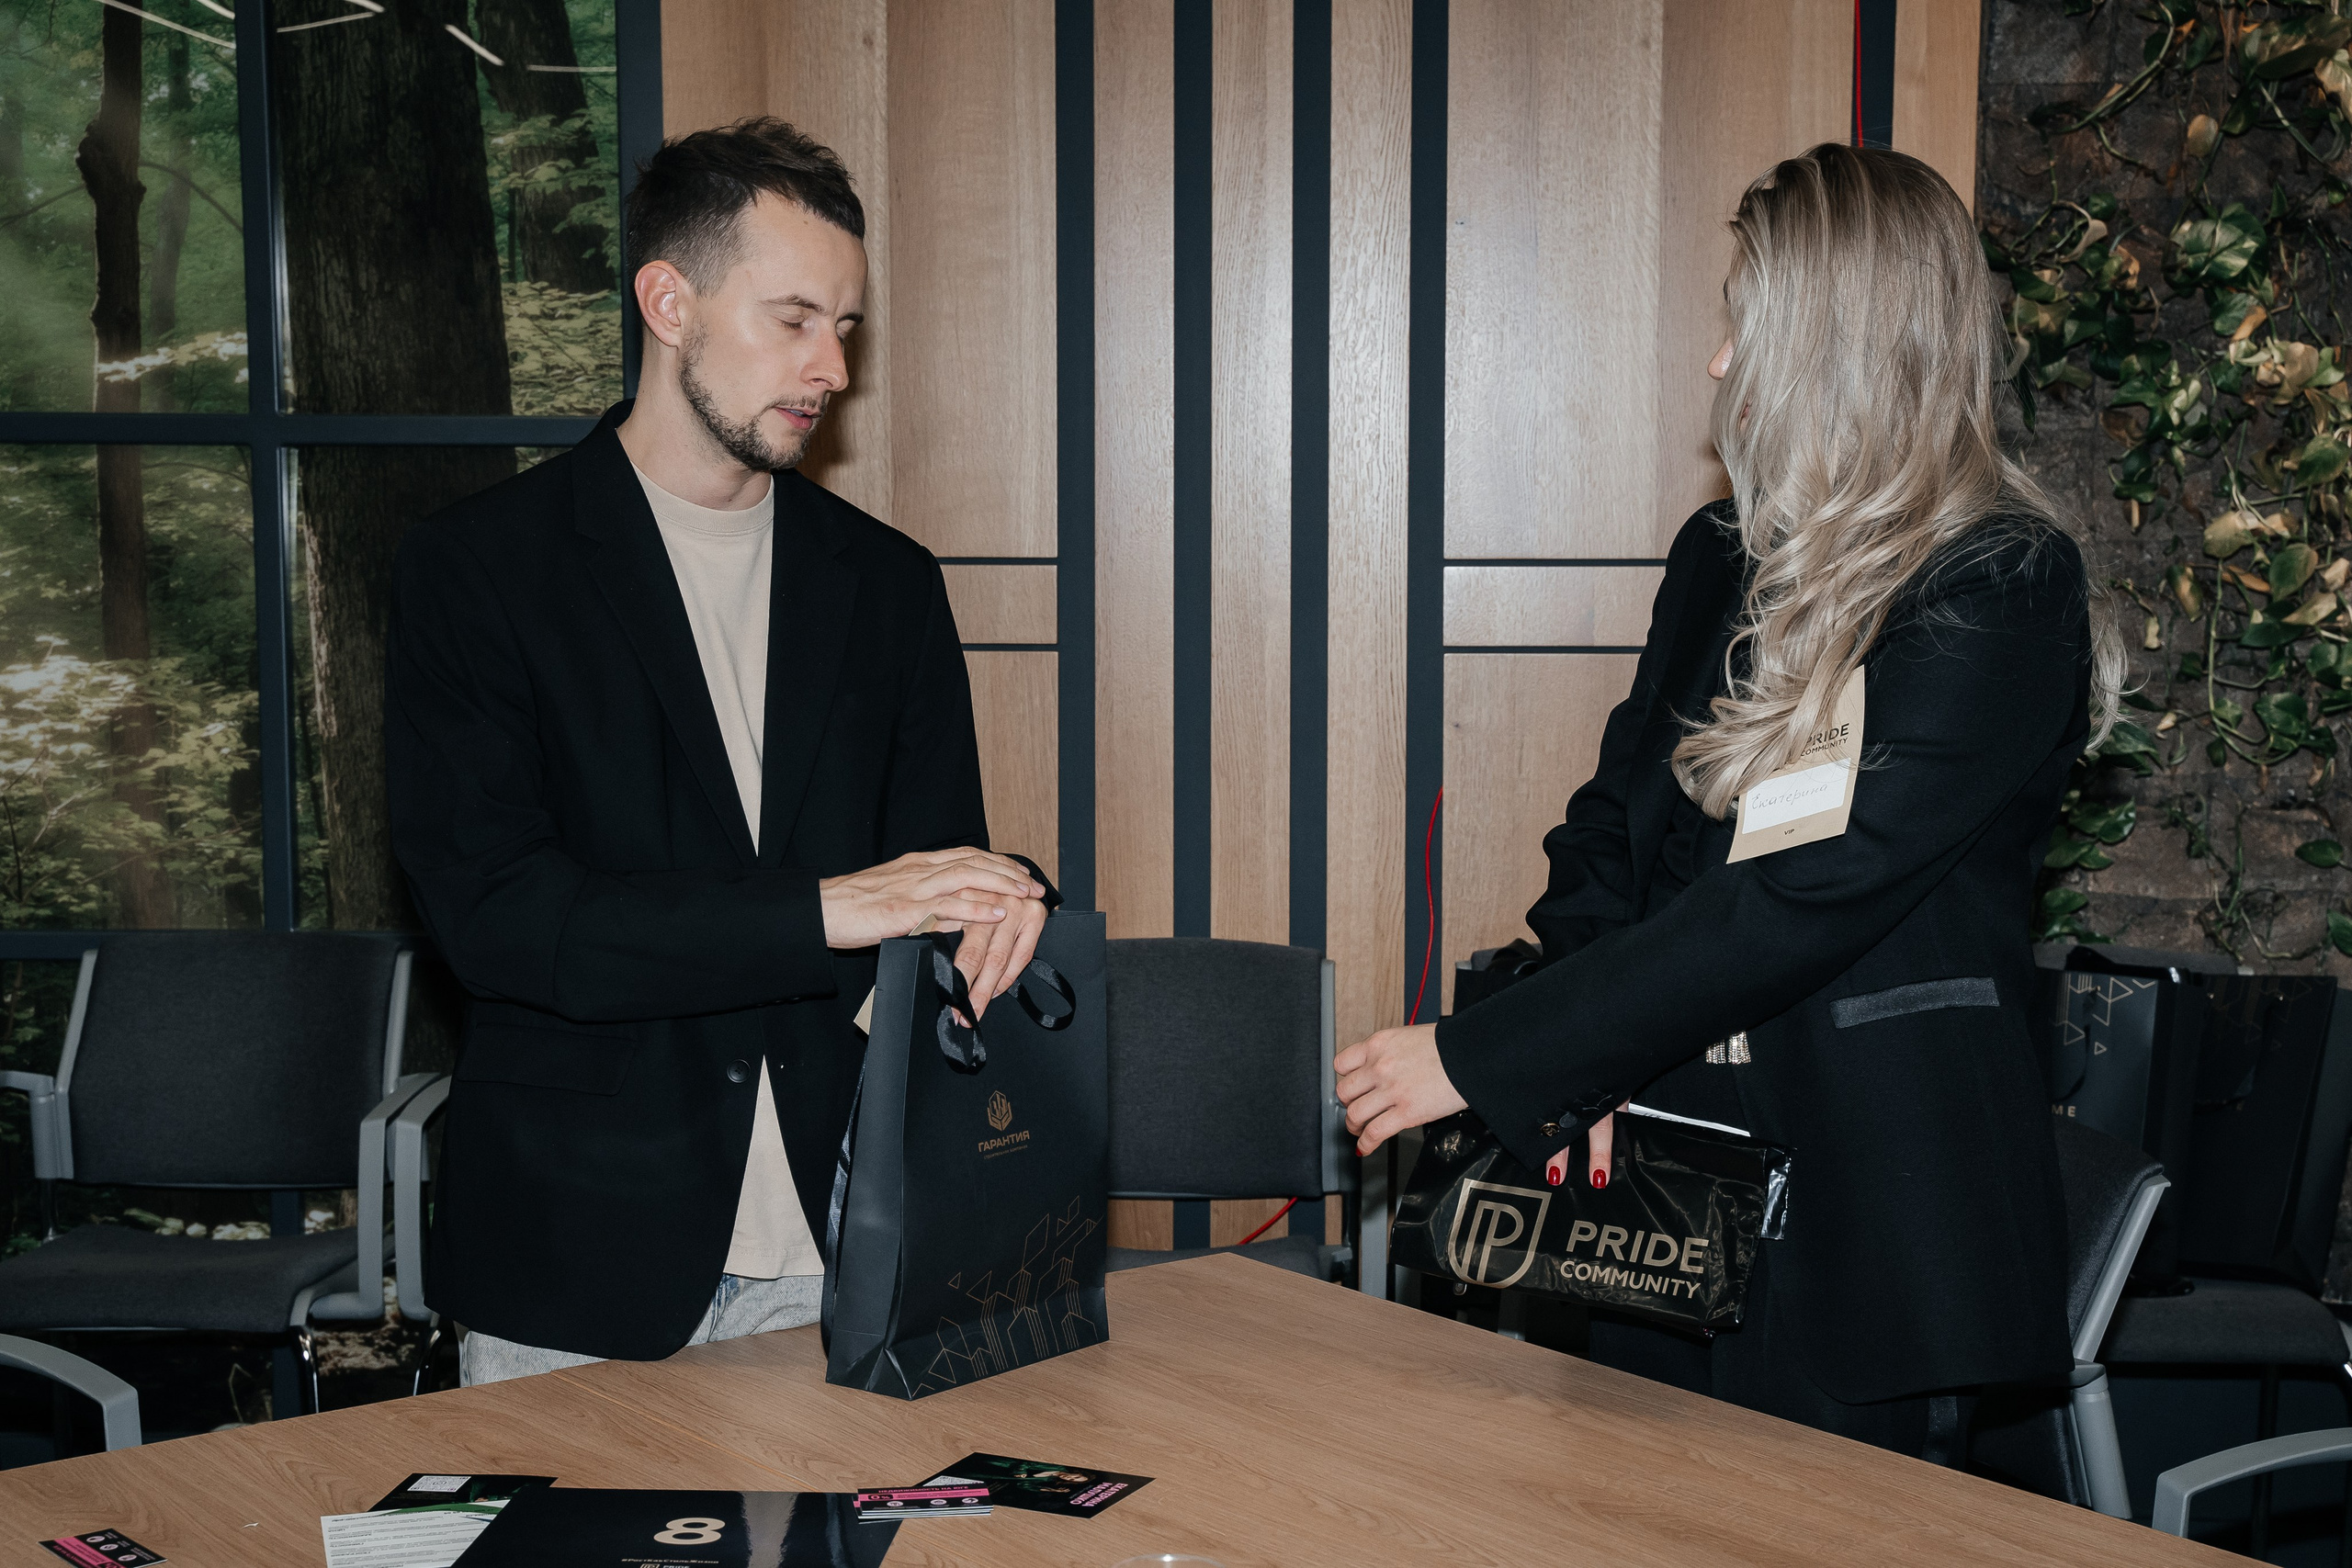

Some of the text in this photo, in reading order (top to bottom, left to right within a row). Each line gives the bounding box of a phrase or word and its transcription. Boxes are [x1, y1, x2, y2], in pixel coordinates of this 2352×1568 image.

[1801, 738, 1849, 756] COMMUNITY
[1751, 784, 1828, 809] Екатерина
[978, 1130, 1030, 1153] ГАРАНТИЯ
[1566, 1219, 1710, 1275] PRIDE
[1559, 1260, 1702, 1300] COMMUNITY
[653, 1517, 726, 1545] 8
